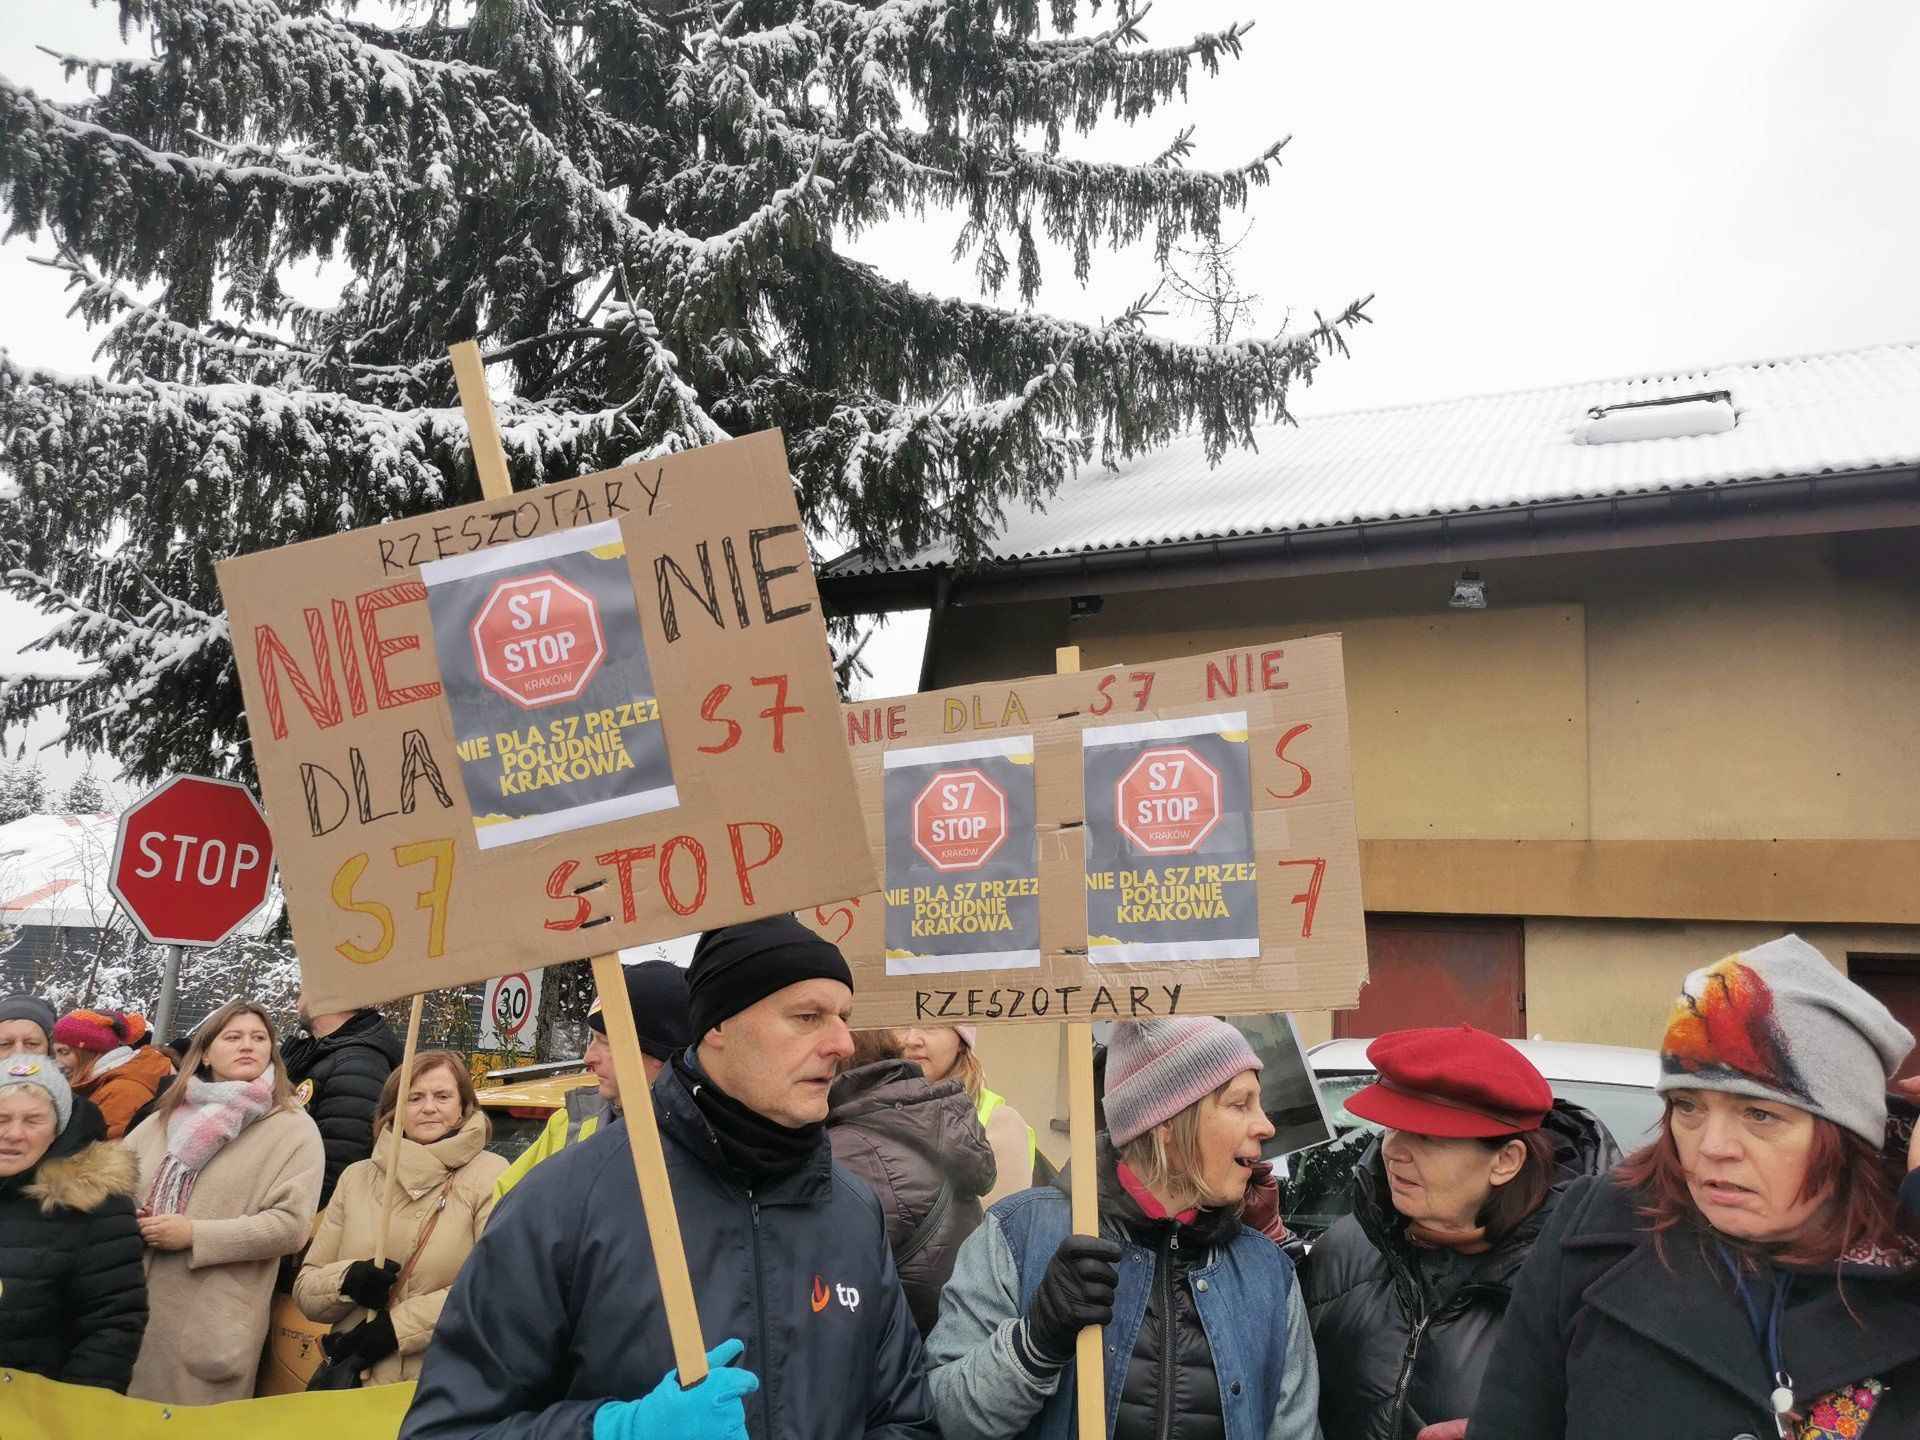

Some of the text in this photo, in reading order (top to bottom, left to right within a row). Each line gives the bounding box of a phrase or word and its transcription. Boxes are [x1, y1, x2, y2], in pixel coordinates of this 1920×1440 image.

[379, 468, 663, 575] RZESZOTARY
[653, 522, 812, 644] NIE
[508, 589, 552, 631] S7
[254, 580, 442, 741] NIE
[503, 631, 577, 673] STOP
[524, 670, 573, 692] KRAKÓW
[847, 650, 1289, 747] NIE DLA S7 NIE
[495, 725, 546, 756] DLA
[549, 716, 580, 742] S7
[585, 699, 664, 734] PRZEZ
[695, 673, 805, 754] S7
[502, 729, 625, 775] POŁUDNIE
[1265, 723, 1313, 799] S
[300, 729, 455, 837] DLA
[499, 749, 635, 797] KRAKOWA
[1148, 760, 1185, 791] S7
[942, 781, 976, 811] S7
[1137, 797, 1199, 824] STOP
[931, 816, 987, 843] STOP
[1149, 828, 1191, 841] KRAKÓW
[135, 831, 260, 889] STOP
[941, 846, 979, 859] KRAKÓW
[543, 821, 784, 932] STOP
[914, 885, 949, 904] DLA
[953, 882, 977, 901] S7
[980, 878, 1039, 899] PRZEZ
[1120, 869, 1159, 889] DLA
[1164, 867, 1190, 886] S7
[1122, 882, 1223, 906] POŁUDNIE
[331, 838, 456, 965] S7
[915, 898, 1007, 920] POŁUDNIE
[1117, 900, 1230, 924] KRAKOWA
[1277, 857, 1327, 939] 7
[911, 913, 1013, 937] KRAKOWA
[497, 987, 526, 1019] 30
[915, 983, 1182, 1021] RZESZOTARY
[836, 1283, 860, 1313] tp
